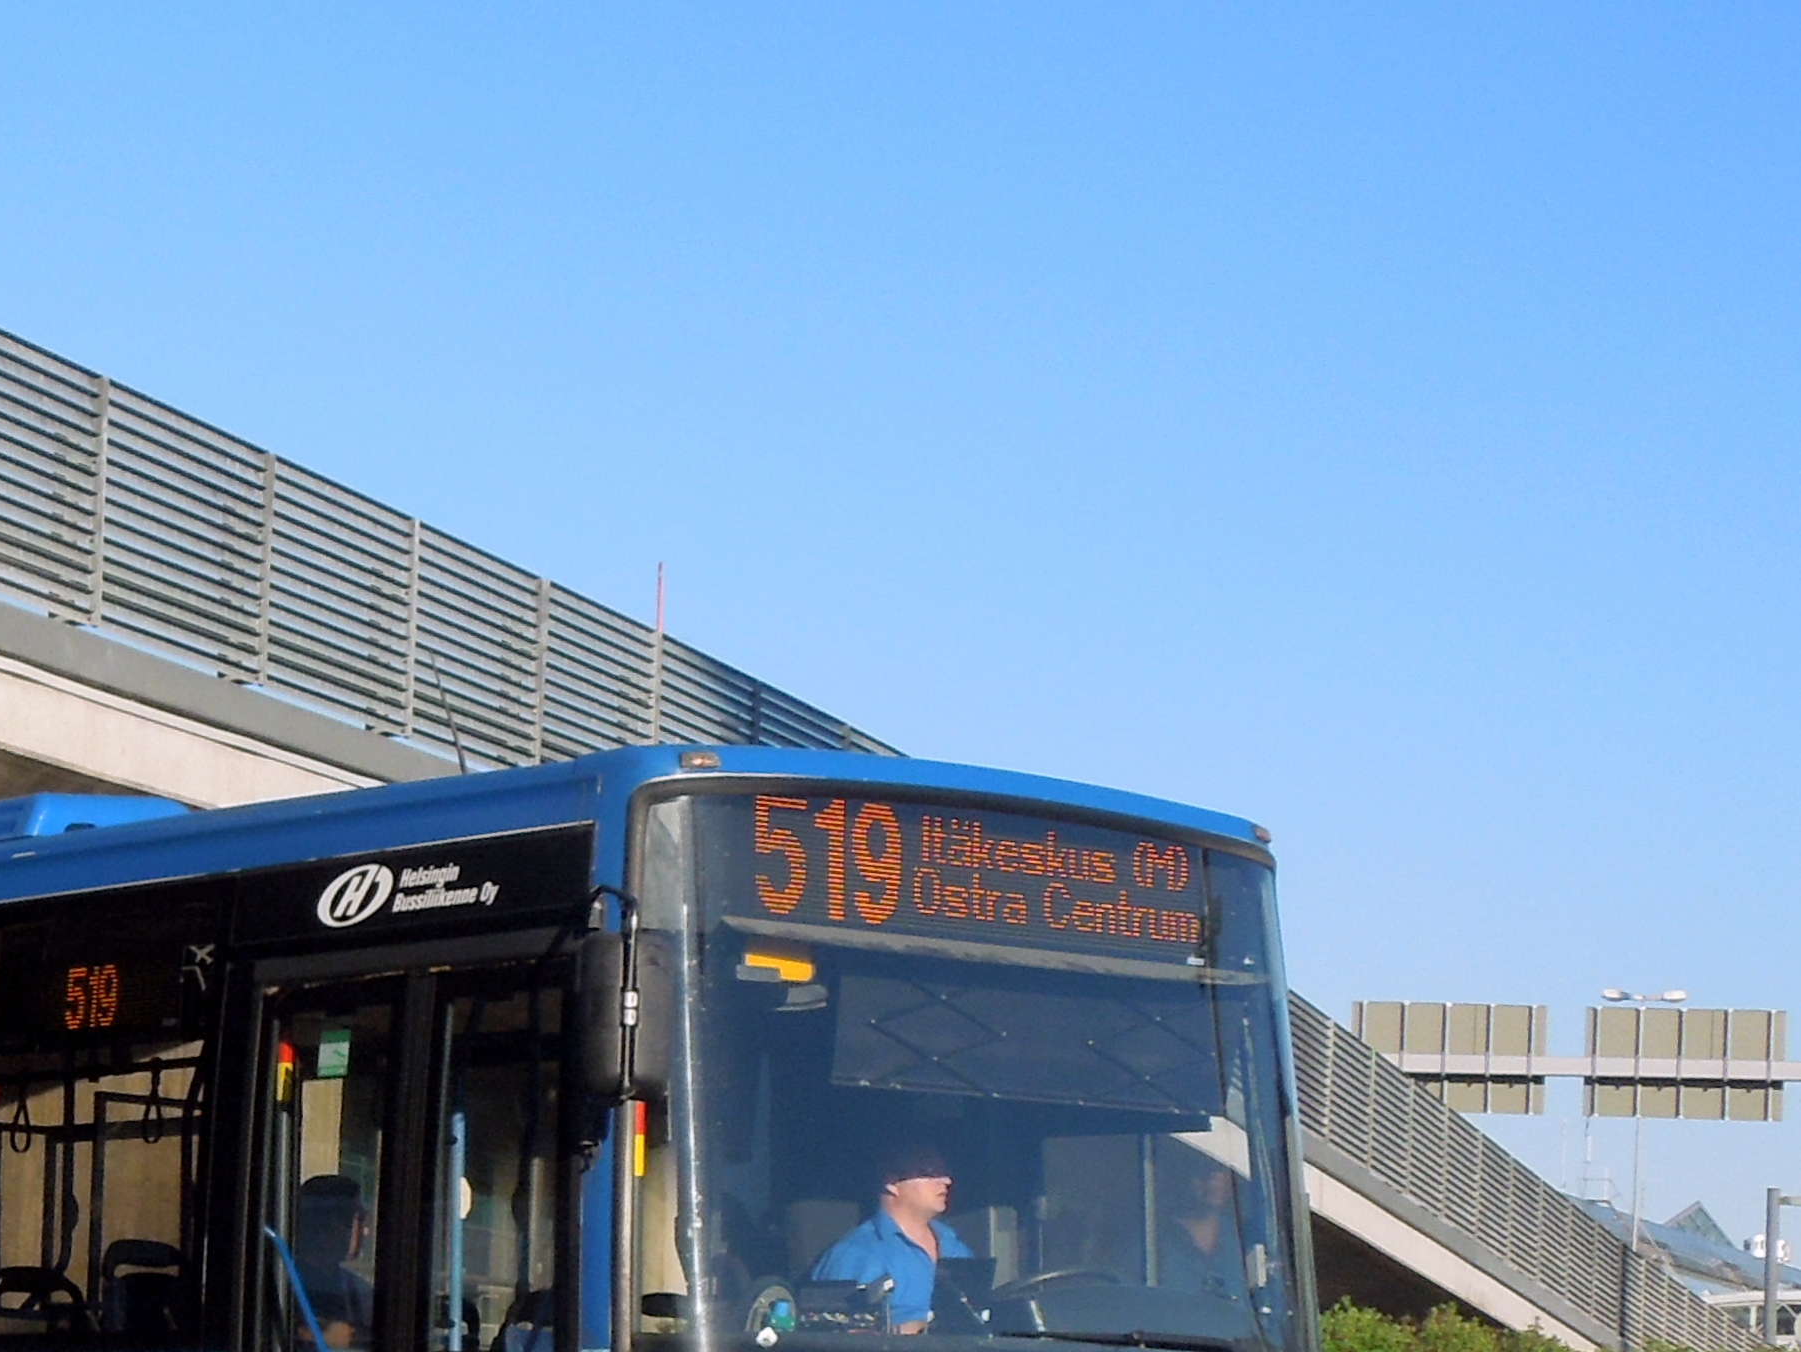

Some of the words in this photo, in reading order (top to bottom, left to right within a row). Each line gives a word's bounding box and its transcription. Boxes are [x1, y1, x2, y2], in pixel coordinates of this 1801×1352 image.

[398, 862, 460, 889] Helsingin
[755, 795, 903, 925] 519
[922, 815, 1116, 884] Itäkeskus
[1132, 840, 1189, 892] (M)
[1043, 882, 1199, 944] Centrum
[64, 964, 119, 1030] 519
